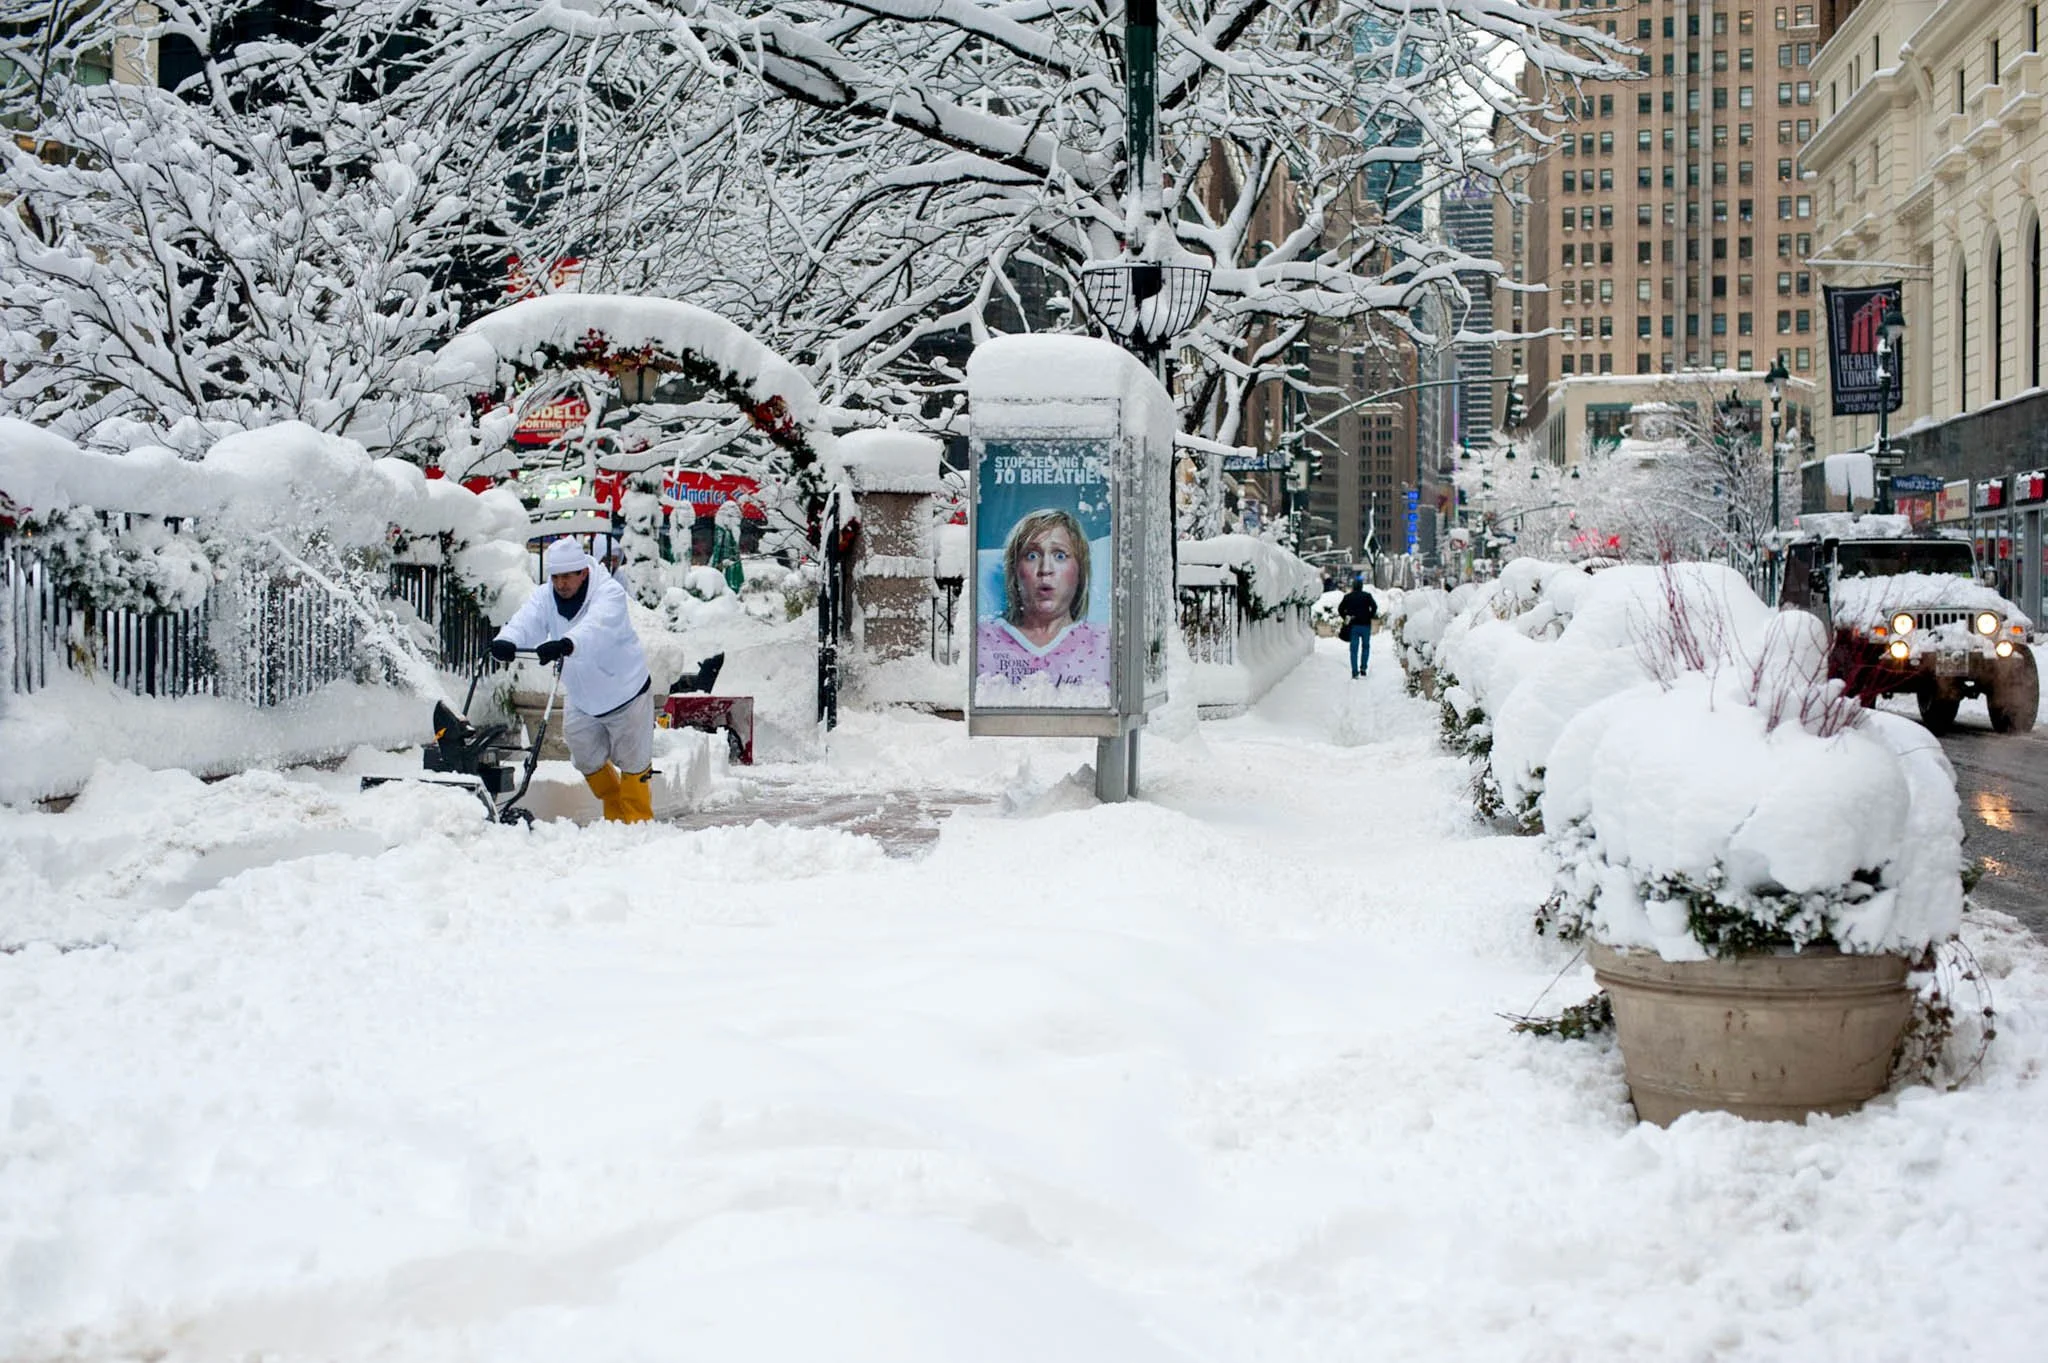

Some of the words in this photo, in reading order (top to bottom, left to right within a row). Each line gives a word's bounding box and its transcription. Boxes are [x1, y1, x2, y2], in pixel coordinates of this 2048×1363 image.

[994, 456, 1025, 468] STOP
[994, 468, 1016, 484] TO
[680, 484, 728, 504] America
[1000, 659, 1030, 671] BORN
